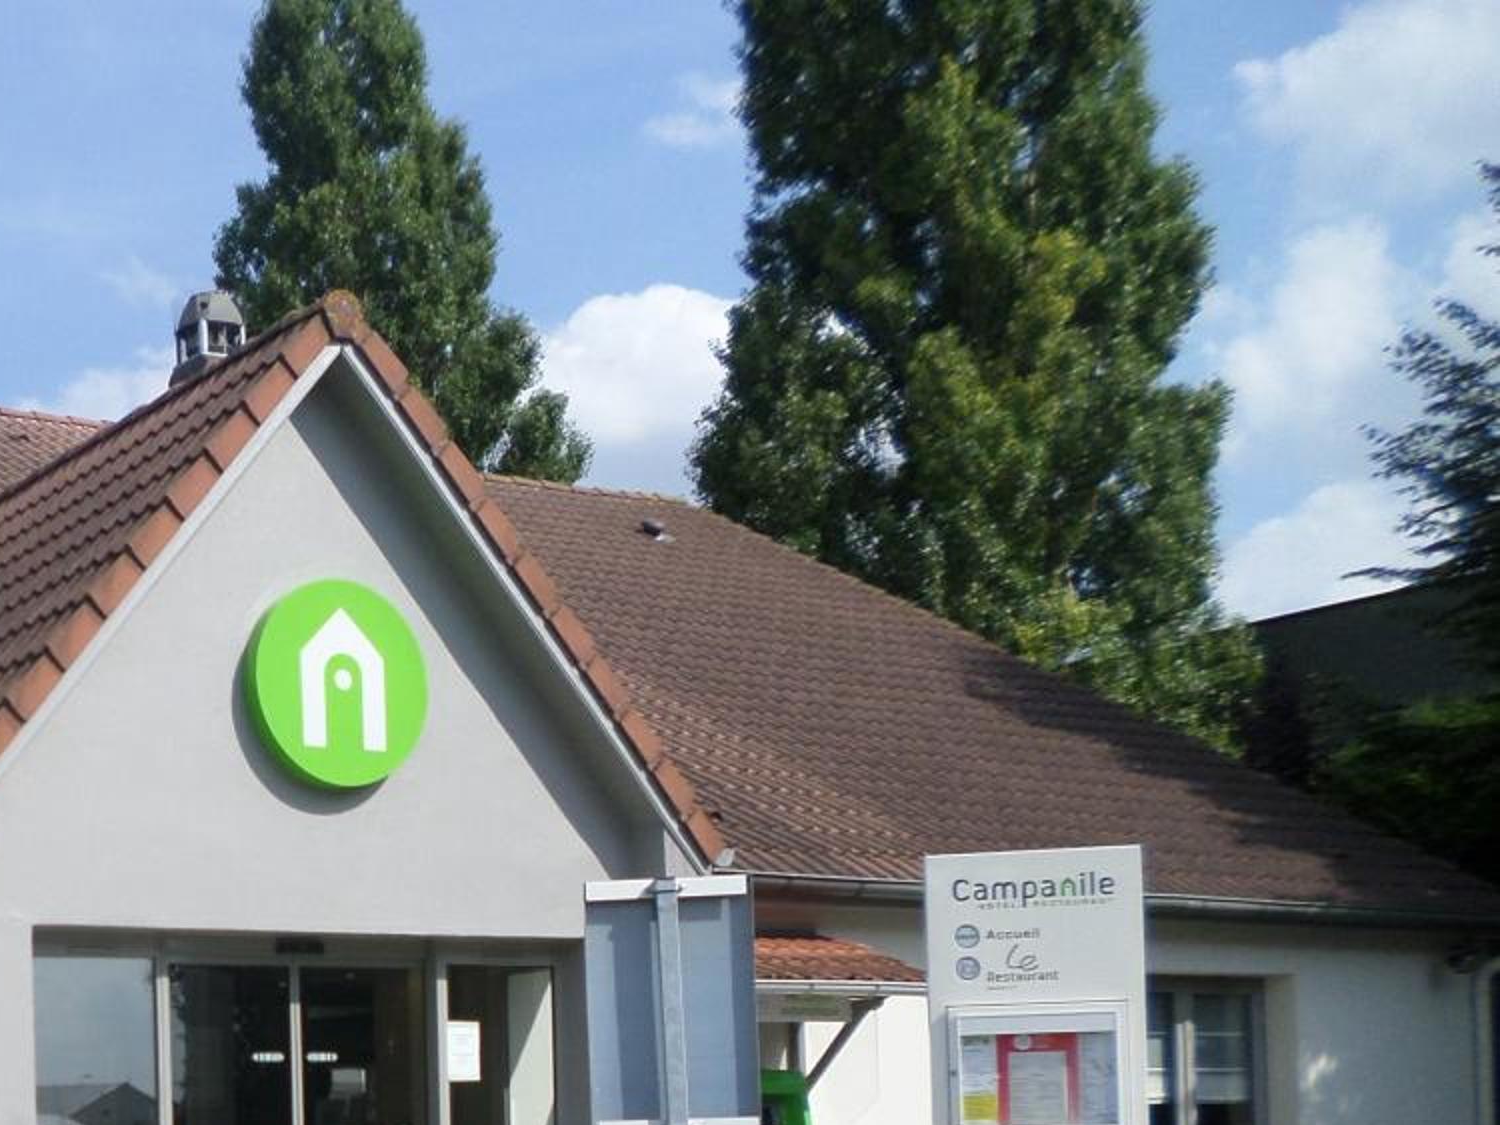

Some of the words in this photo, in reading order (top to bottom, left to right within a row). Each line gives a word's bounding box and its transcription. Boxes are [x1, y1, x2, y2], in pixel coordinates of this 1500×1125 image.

[952, 872, 1115, 907] Campanile
[986, 928, 1041, 940] Accueil
[1005, 944, 1040, 972] Le
[986, 971, 1060, 983] Restaurant
